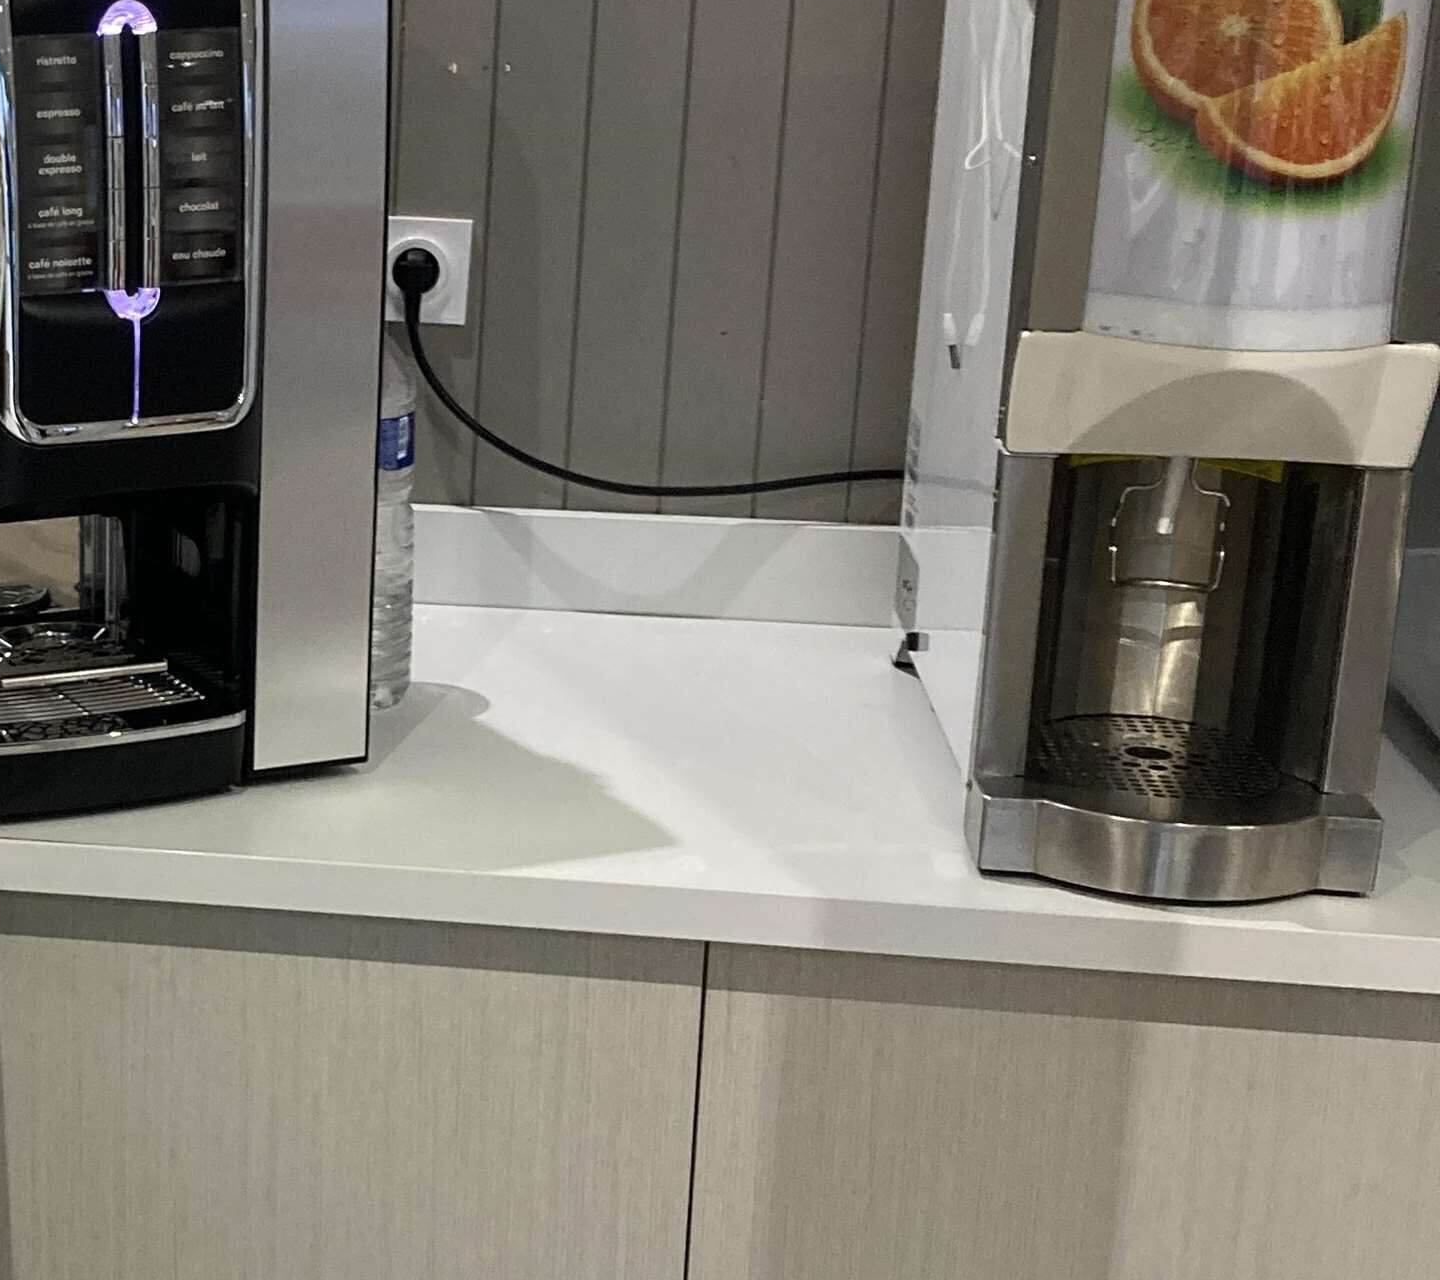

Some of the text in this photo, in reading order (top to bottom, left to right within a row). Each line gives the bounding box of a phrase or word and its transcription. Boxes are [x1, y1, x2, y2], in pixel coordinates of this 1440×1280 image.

[38, 206, 84, 219] café long
[28, 257, 51, 270] café
